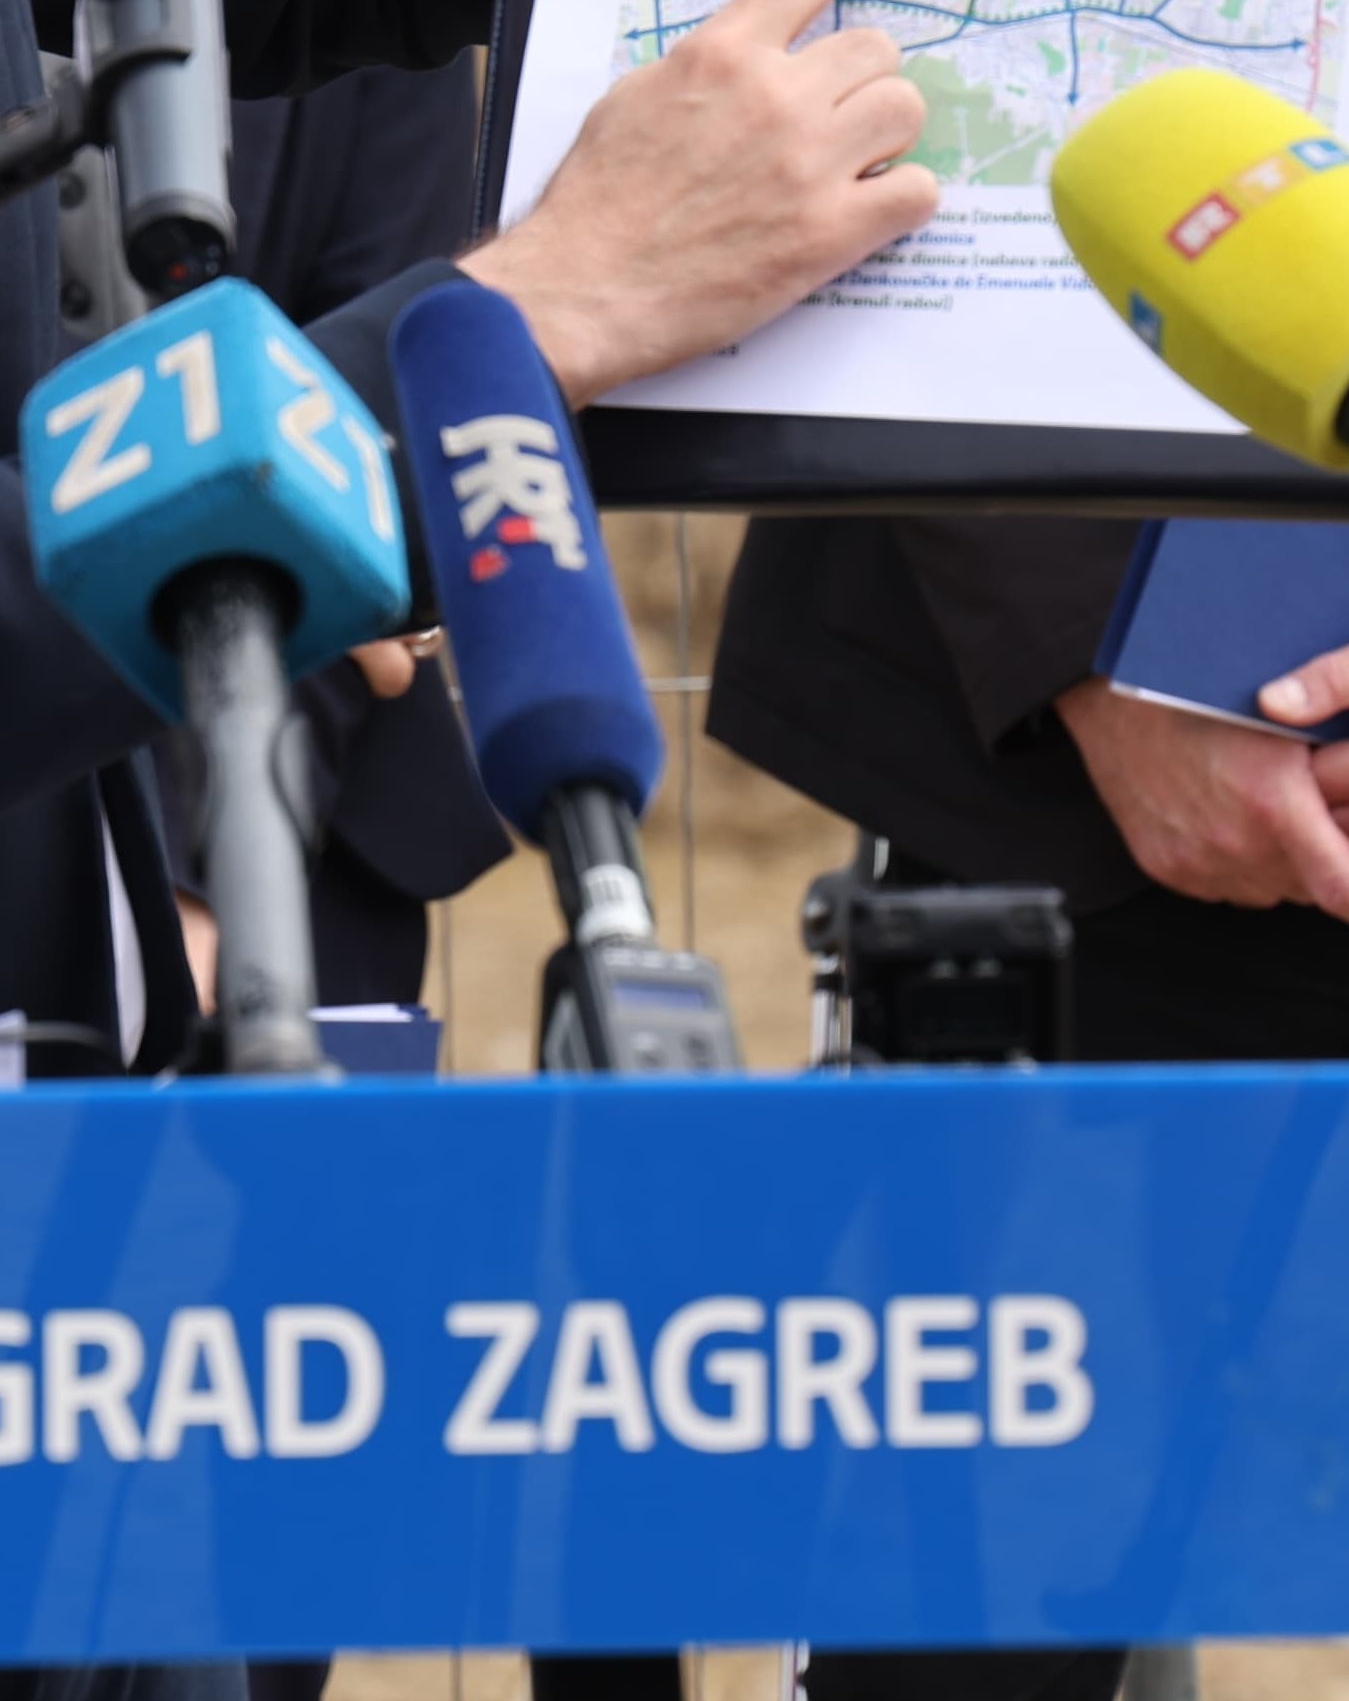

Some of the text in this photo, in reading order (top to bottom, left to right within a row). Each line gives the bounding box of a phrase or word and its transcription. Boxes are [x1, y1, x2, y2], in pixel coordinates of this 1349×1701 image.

[1042, 254, 1079, 269] rado
[47, 330, 220, 515] Z1
[442, 1293, 1095, 1456] ZAGREB
